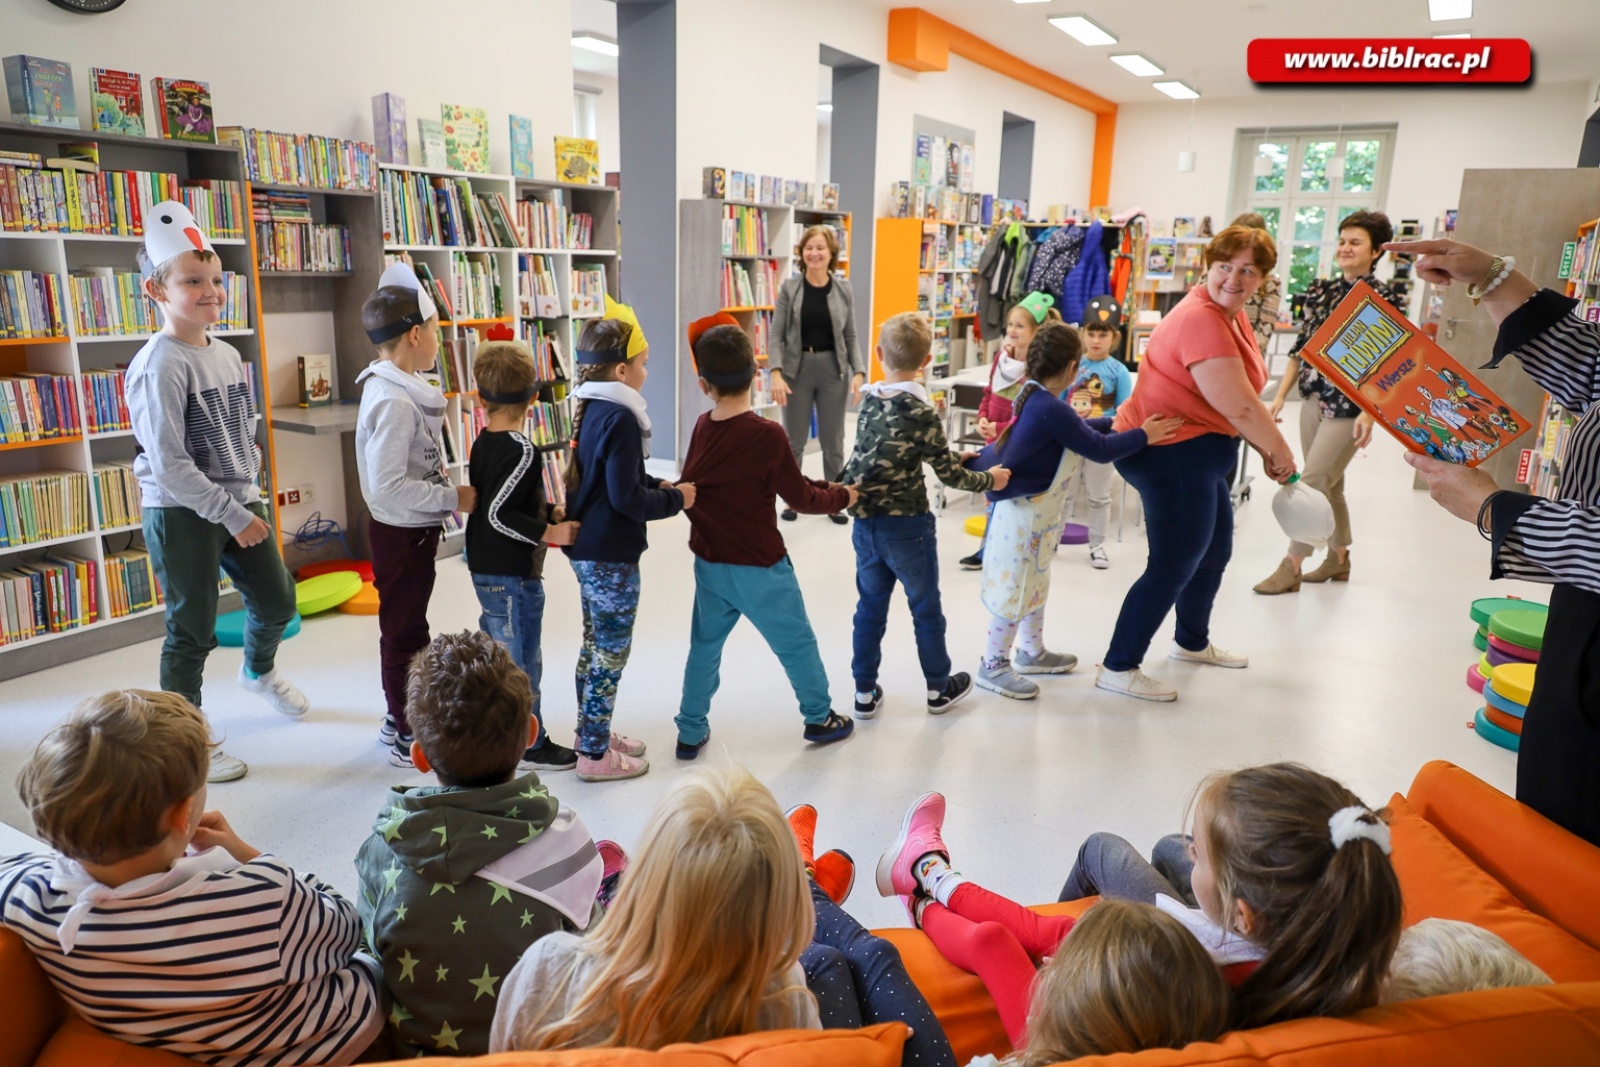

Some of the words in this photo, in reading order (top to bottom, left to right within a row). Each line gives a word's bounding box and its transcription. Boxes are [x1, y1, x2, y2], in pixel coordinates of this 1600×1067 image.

[1564, 245, 1573, 259] LAT
[1338, 317, 1401, 376] TUWIM
[1339, 319, 1367, 350] JULIAN
[1375, 357, 1417, 392] Wiersze
